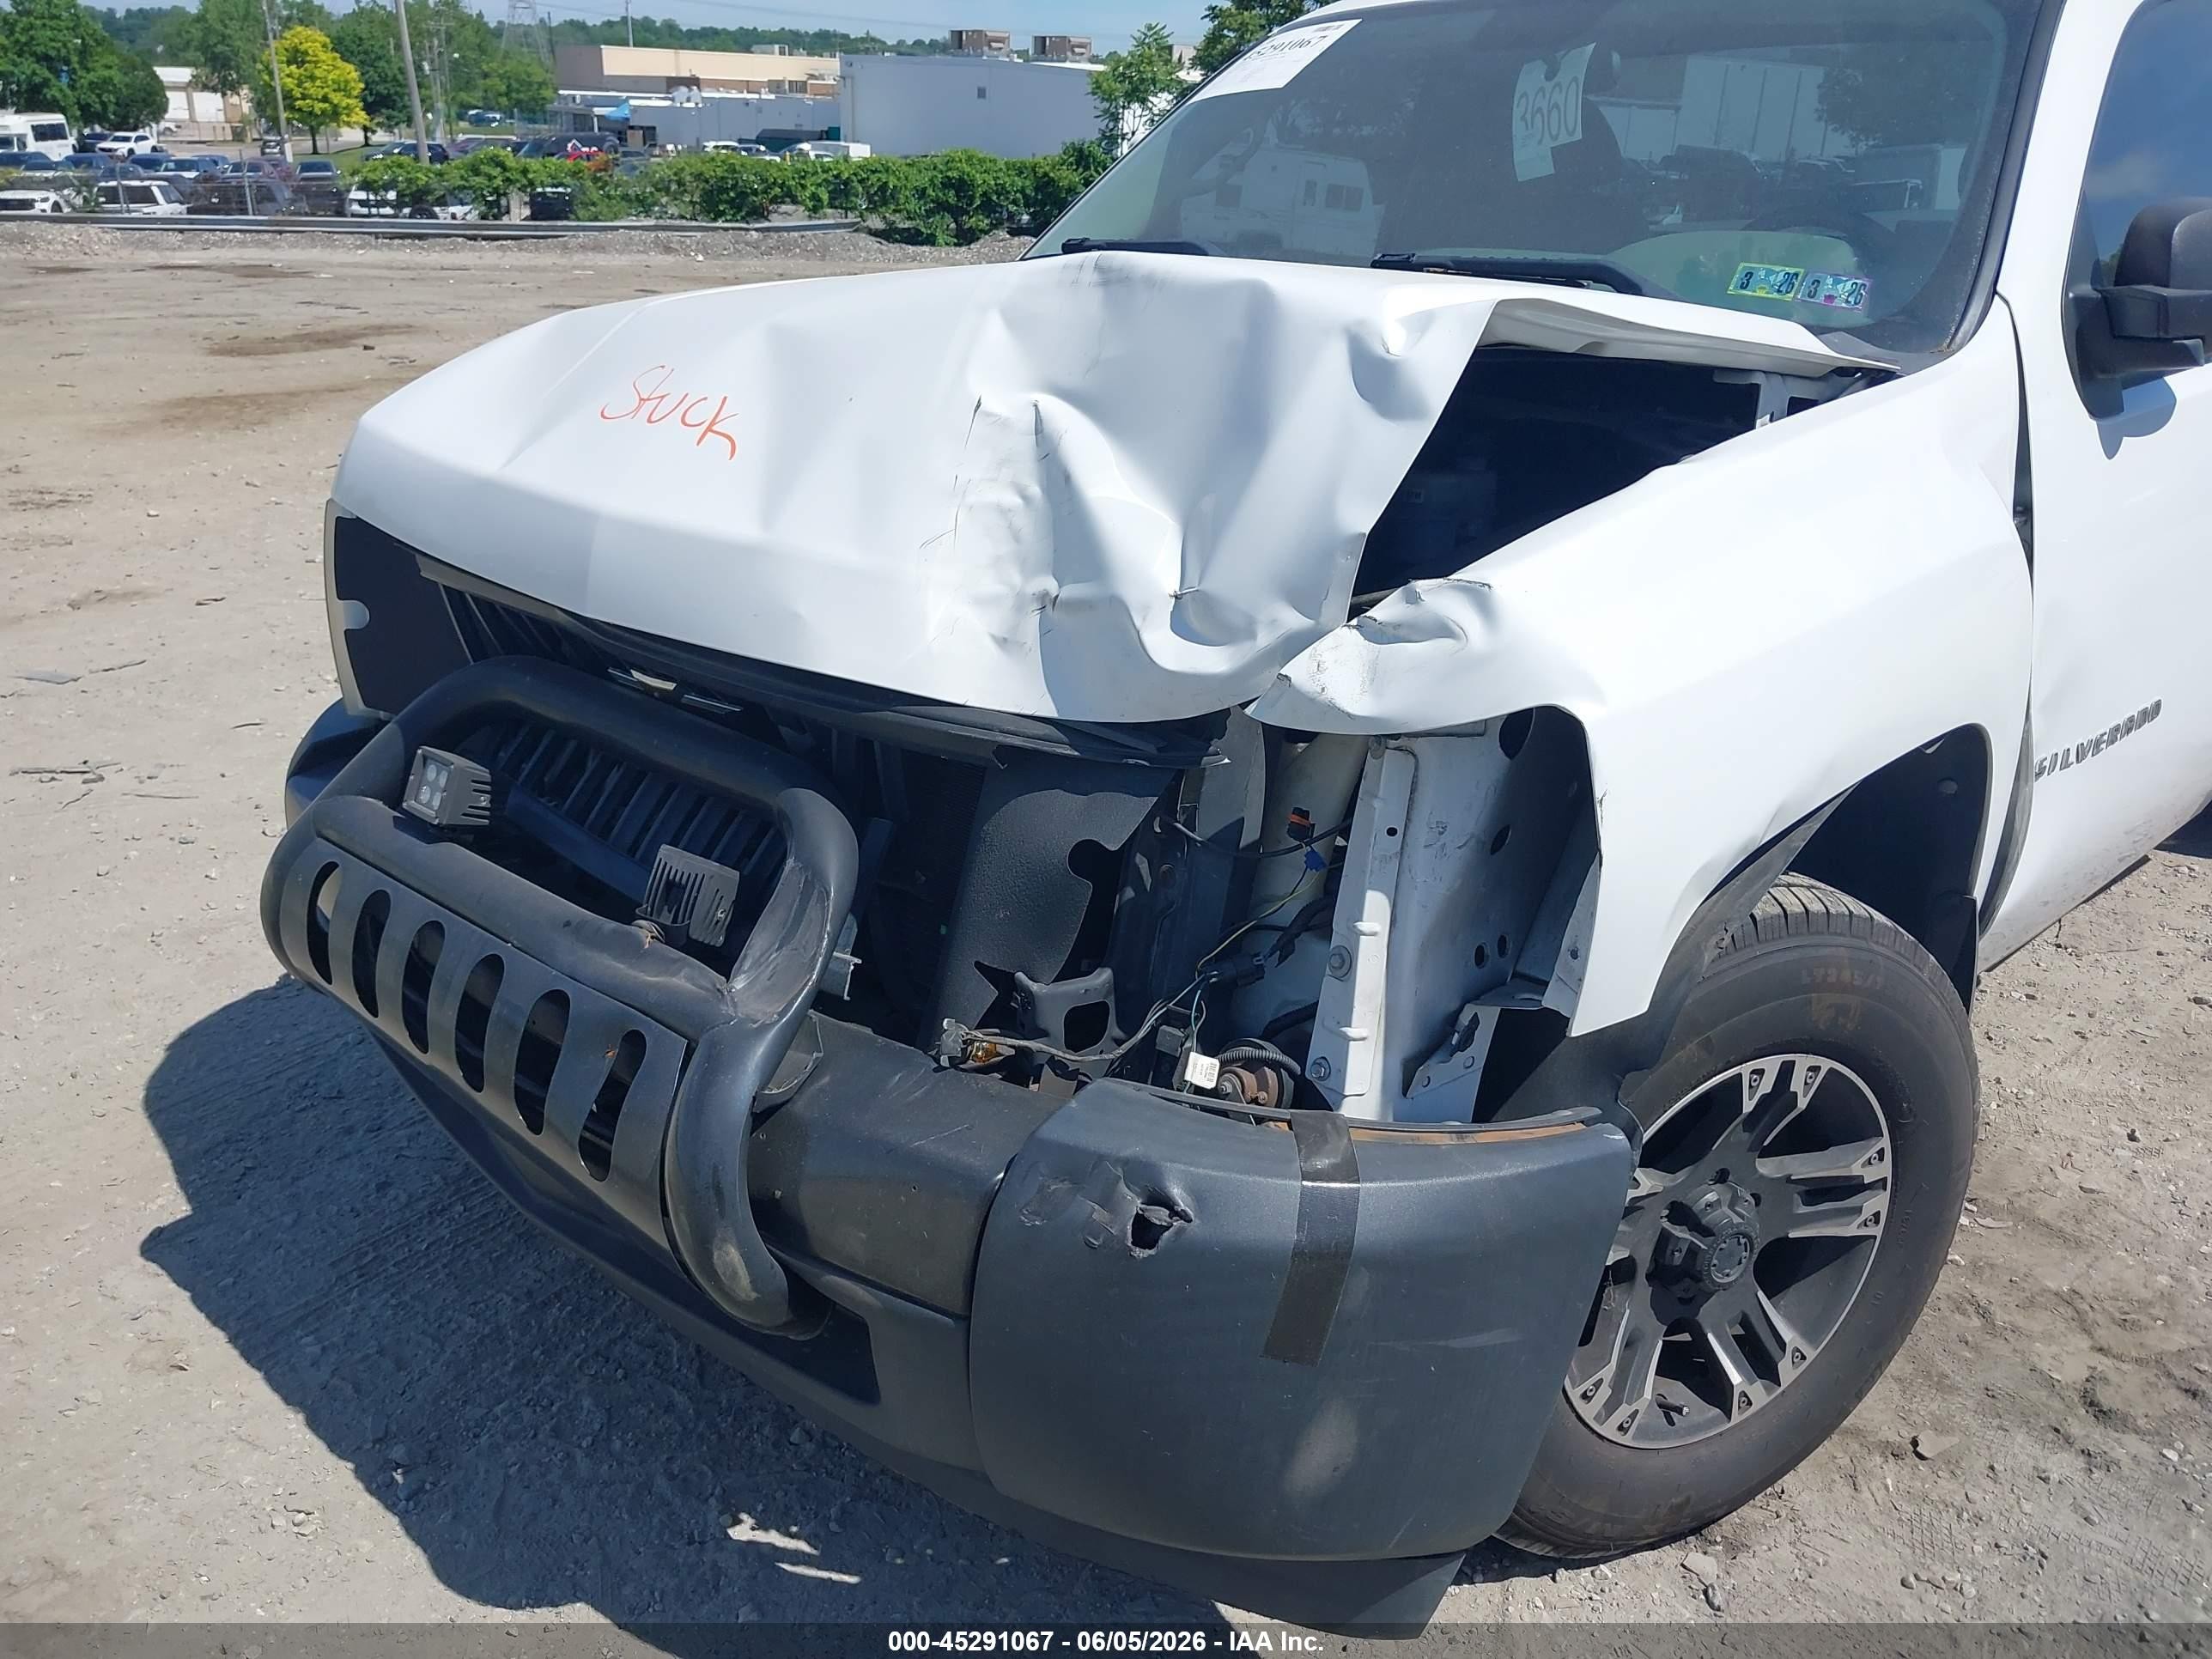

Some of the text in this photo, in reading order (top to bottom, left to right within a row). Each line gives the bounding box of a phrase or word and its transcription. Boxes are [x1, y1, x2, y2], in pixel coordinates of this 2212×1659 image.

[1516, 76, 1578, 145] 3660
[1740, 271, 1799, 295] 3 26
[1808, 279, 1867, 306] 3 26
[2034, 699, 2162, 782] SILVERADO
